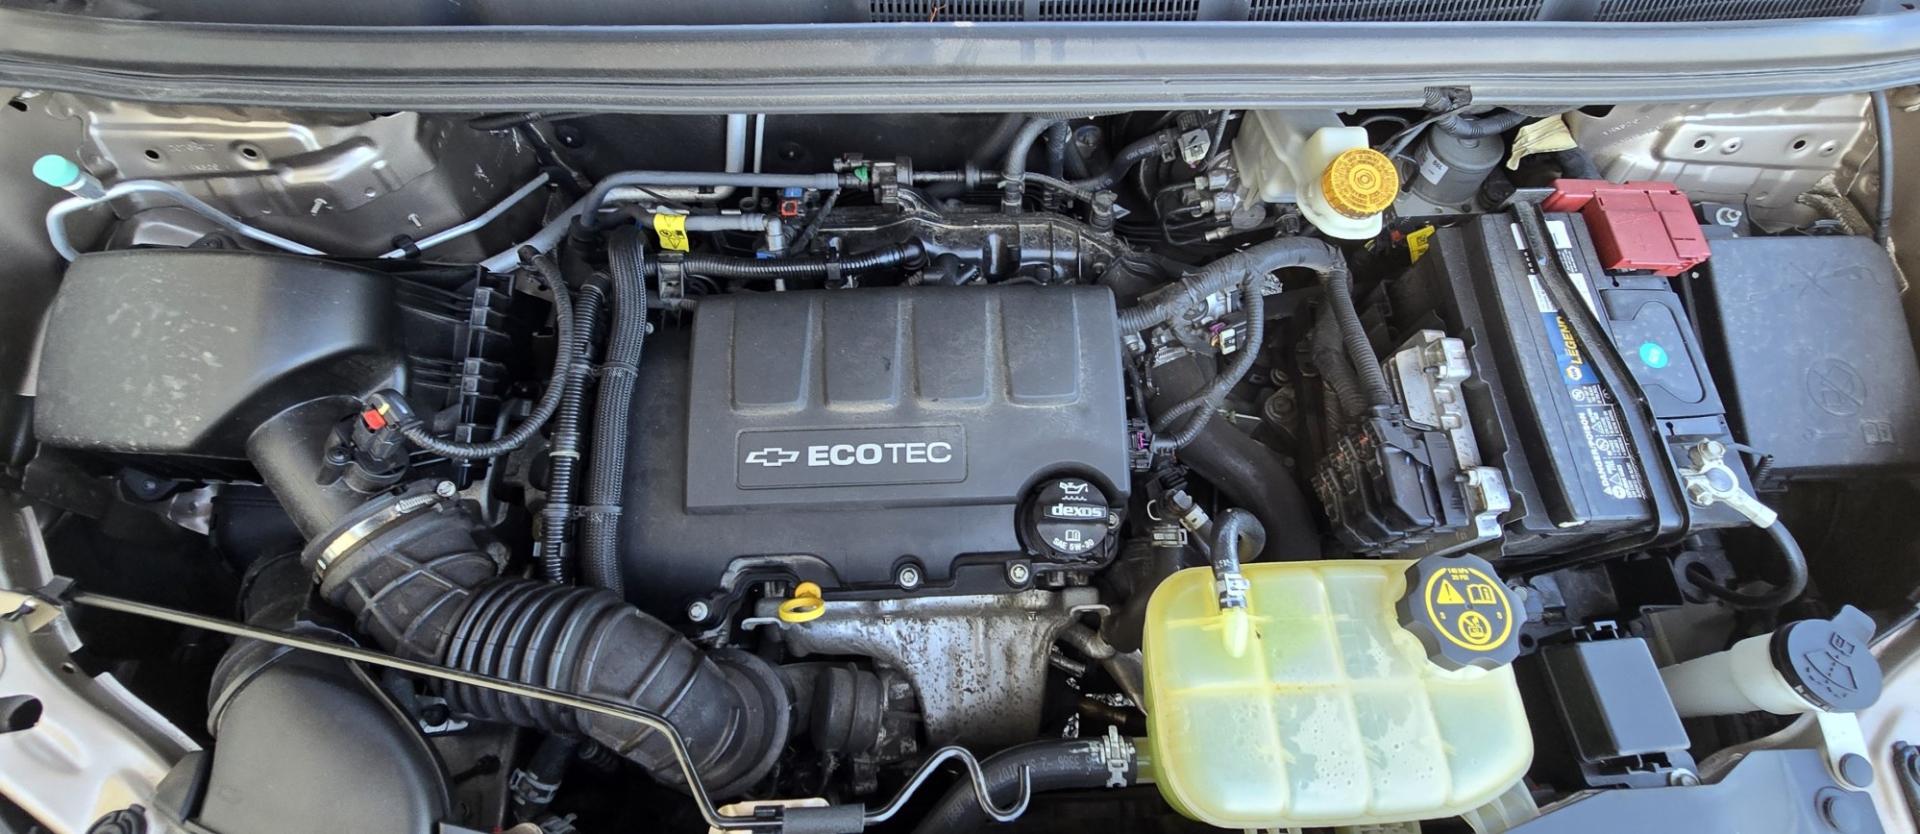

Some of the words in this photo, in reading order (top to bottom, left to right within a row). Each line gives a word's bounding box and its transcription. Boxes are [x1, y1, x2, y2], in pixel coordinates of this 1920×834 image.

[808, 442, 952, 467] ECOTEC
[1051, 503, 1102, 517] dexos
[1053, 538, 1068, 550] SAE
